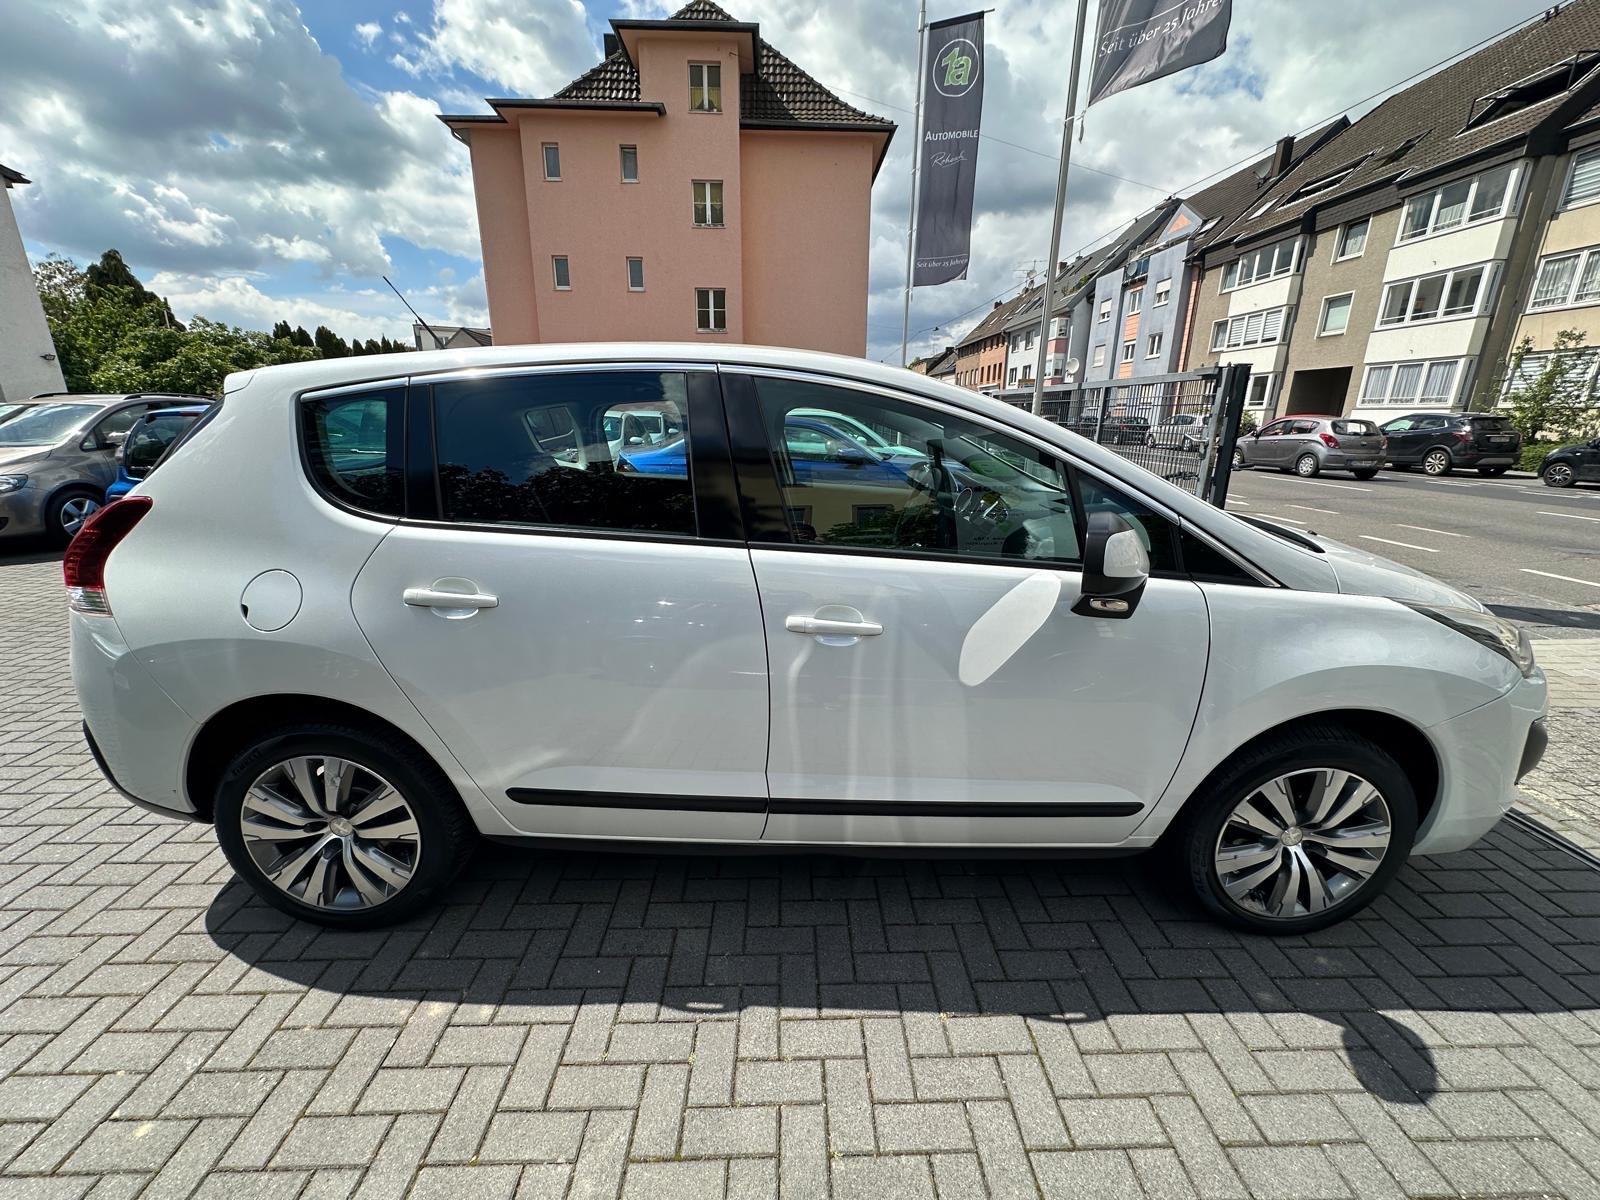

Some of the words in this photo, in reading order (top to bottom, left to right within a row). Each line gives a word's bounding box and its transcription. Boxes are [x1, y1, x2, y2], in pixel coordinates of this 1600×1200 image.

[1099, 36, 1123, 58] Seit
[1128, 25, 1161, 49] über
[1162, 17, 1179, 34] 25
[941, 47, 972, 87] 1a
[924, 129, 979, 142] AUTOMOBILE
